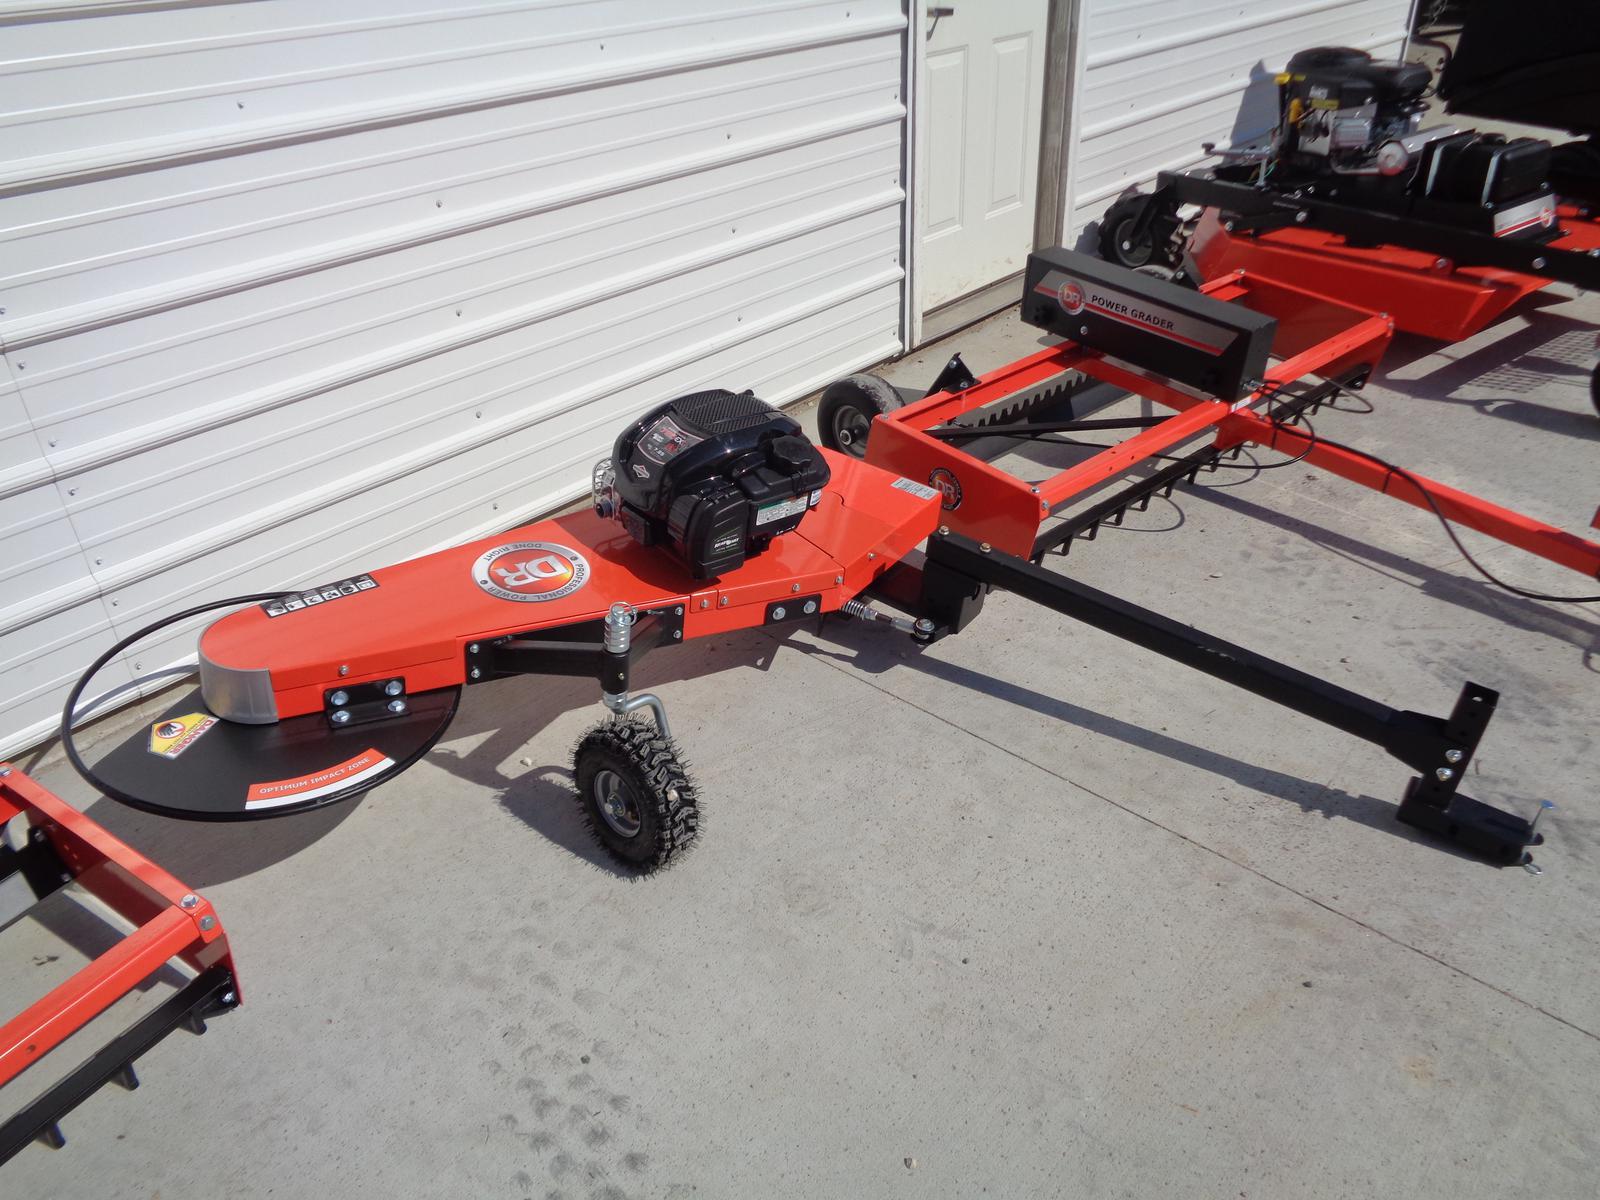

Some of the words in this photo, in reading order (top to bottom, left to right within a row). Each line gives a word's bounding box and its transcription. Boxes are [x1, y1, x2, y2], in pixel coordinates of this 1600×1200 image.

[1091, 295, 1128, 315] POWER
[1130, 308, 1174, 331] GRADER
[483, 546, 510, 562] RIGHT
[495, 555, 570, 587] DR
[487, 586, 528, 601] POWER
[534, 563, 585, 601] PROFESSIONAL
[168, 719, 214, 754] DANGER
[259, 780, 308, 794] OPTIMUM
[310, 769, 346, 784] IMPACT
[347, 756, 371, 771] ZONE
